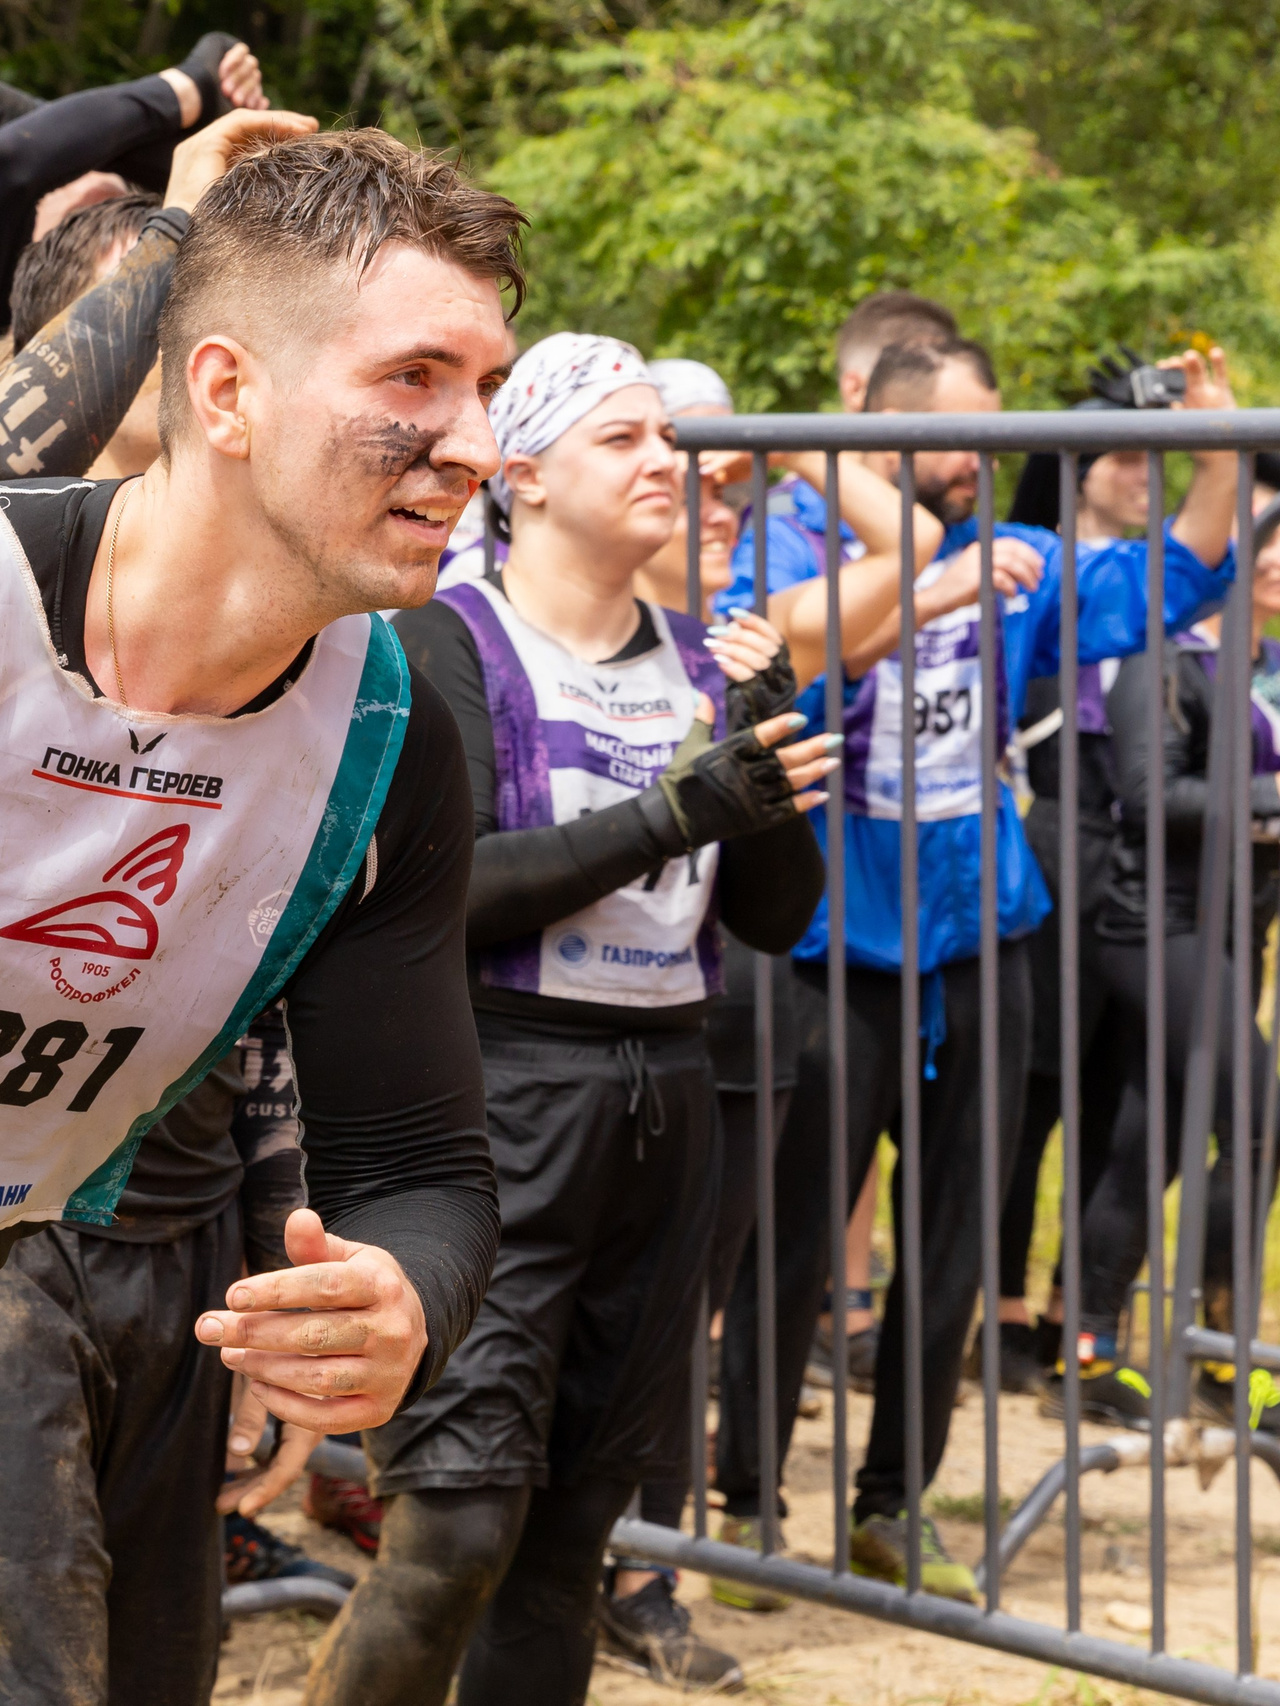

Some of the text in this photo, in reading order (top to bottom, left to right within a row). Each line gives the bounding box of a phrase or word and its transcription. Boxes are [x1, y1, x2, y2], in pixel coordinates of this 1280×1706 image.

[41, 746, 224, 799] ГОНКА ГЕРОЕВ
[49, 956, 142, 1004] РОСПРОФЖЕЛ
[81, 962, 111, 977] 1905
